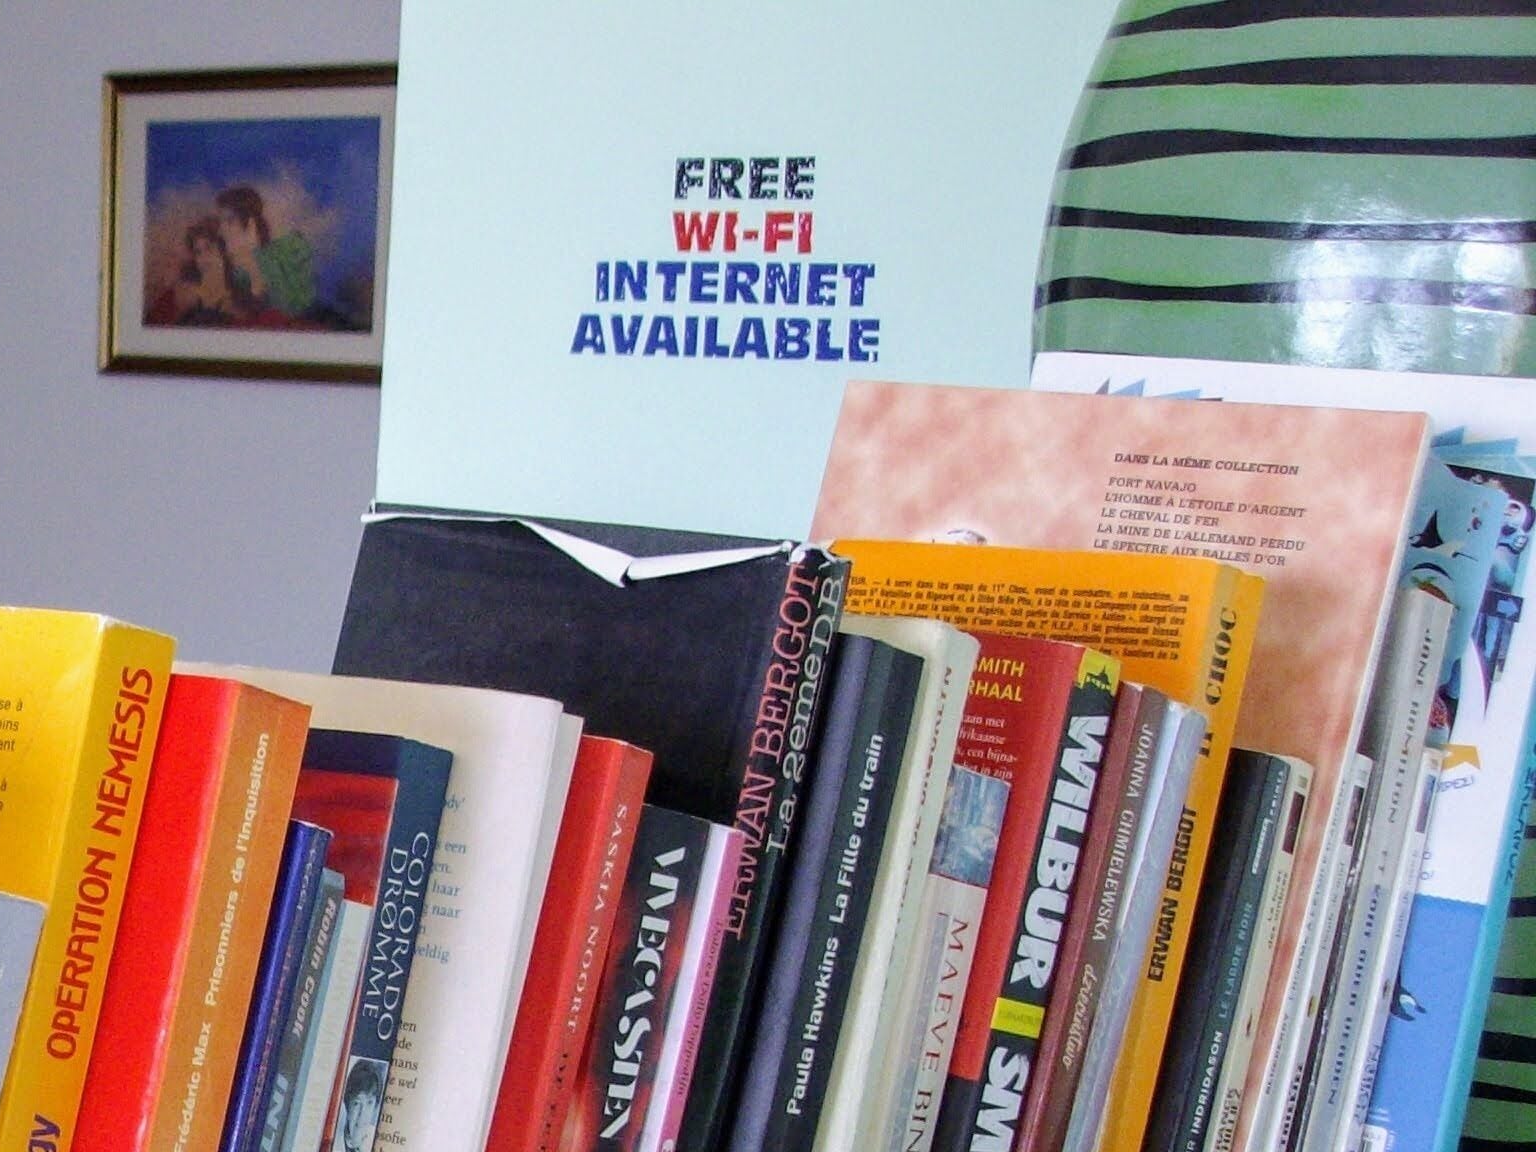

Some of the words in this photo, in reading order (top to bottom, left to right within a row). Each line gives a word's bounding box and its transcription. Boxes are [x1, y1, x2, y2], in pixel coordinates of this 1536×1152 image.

[674, 156, 816, 201] FREE
[672, 210, 813, 254] WI-FI
[595, 260, 876, 307] INTERNET
[570, 313, 881, 363] AVAILABLE
[1108, 477, 1143, 489] FORT
[1145, 479, 1197, 493] NAVAJO
[1114, 453, 1149, 466] DANS
[1152, 455, 1168, 466] LA
[1215, 460, 1299, 476] COLLECTION
[1112, 540, 1167, 556] SPECTRE
[1116, 525, 1150, 538] MINE
[1260, 537, 1305, 551] PERDU
[1120, 509, 1169, 523] CHEVAL
[1195, 515, 1220, 527] FER
[753, 563, 820, 762] BERGOT
[859, 734, 884, 793] train
[1126, 724, 1153, 798] JOANNA
[234, 733, 268, 853] l'Inquisition
[852, 798, 870, 828] du
[594, 803, 627, 911] SASKIA
[766, 799, 796, 855] La
[1010, 716, 1109, 989] WILBUR
[46, 847, 117, 1060] OPERATION
[92, 667, 153, 836] NEMESIS
[232, 856, 246, 884] de
[836, 837, 862, 887] Fille
[1092, 811, 1135, 941] CHMIELEWSKA
[1147, 898, 1178, 983] ERWAN
[1166, 804, 1197, 895] BERGOT
[362, 847, 410, 1020] DRØMME
[376, 831, 430, 1041] COLORADO
[828, 894, 849, 924] La
[204, 888, 241, 1006] Prisonniers
[568, 925, 601, 1033] NOORT
[802, 937, 840, 1042] Hawkins
[922, 918, 969, 1072] MAEVE
[191, 1022, 212, 1057] Max
[786, 1047, 815, 1115] Paula
[1192, 1030, 1222, 1134] INDRIDASON
